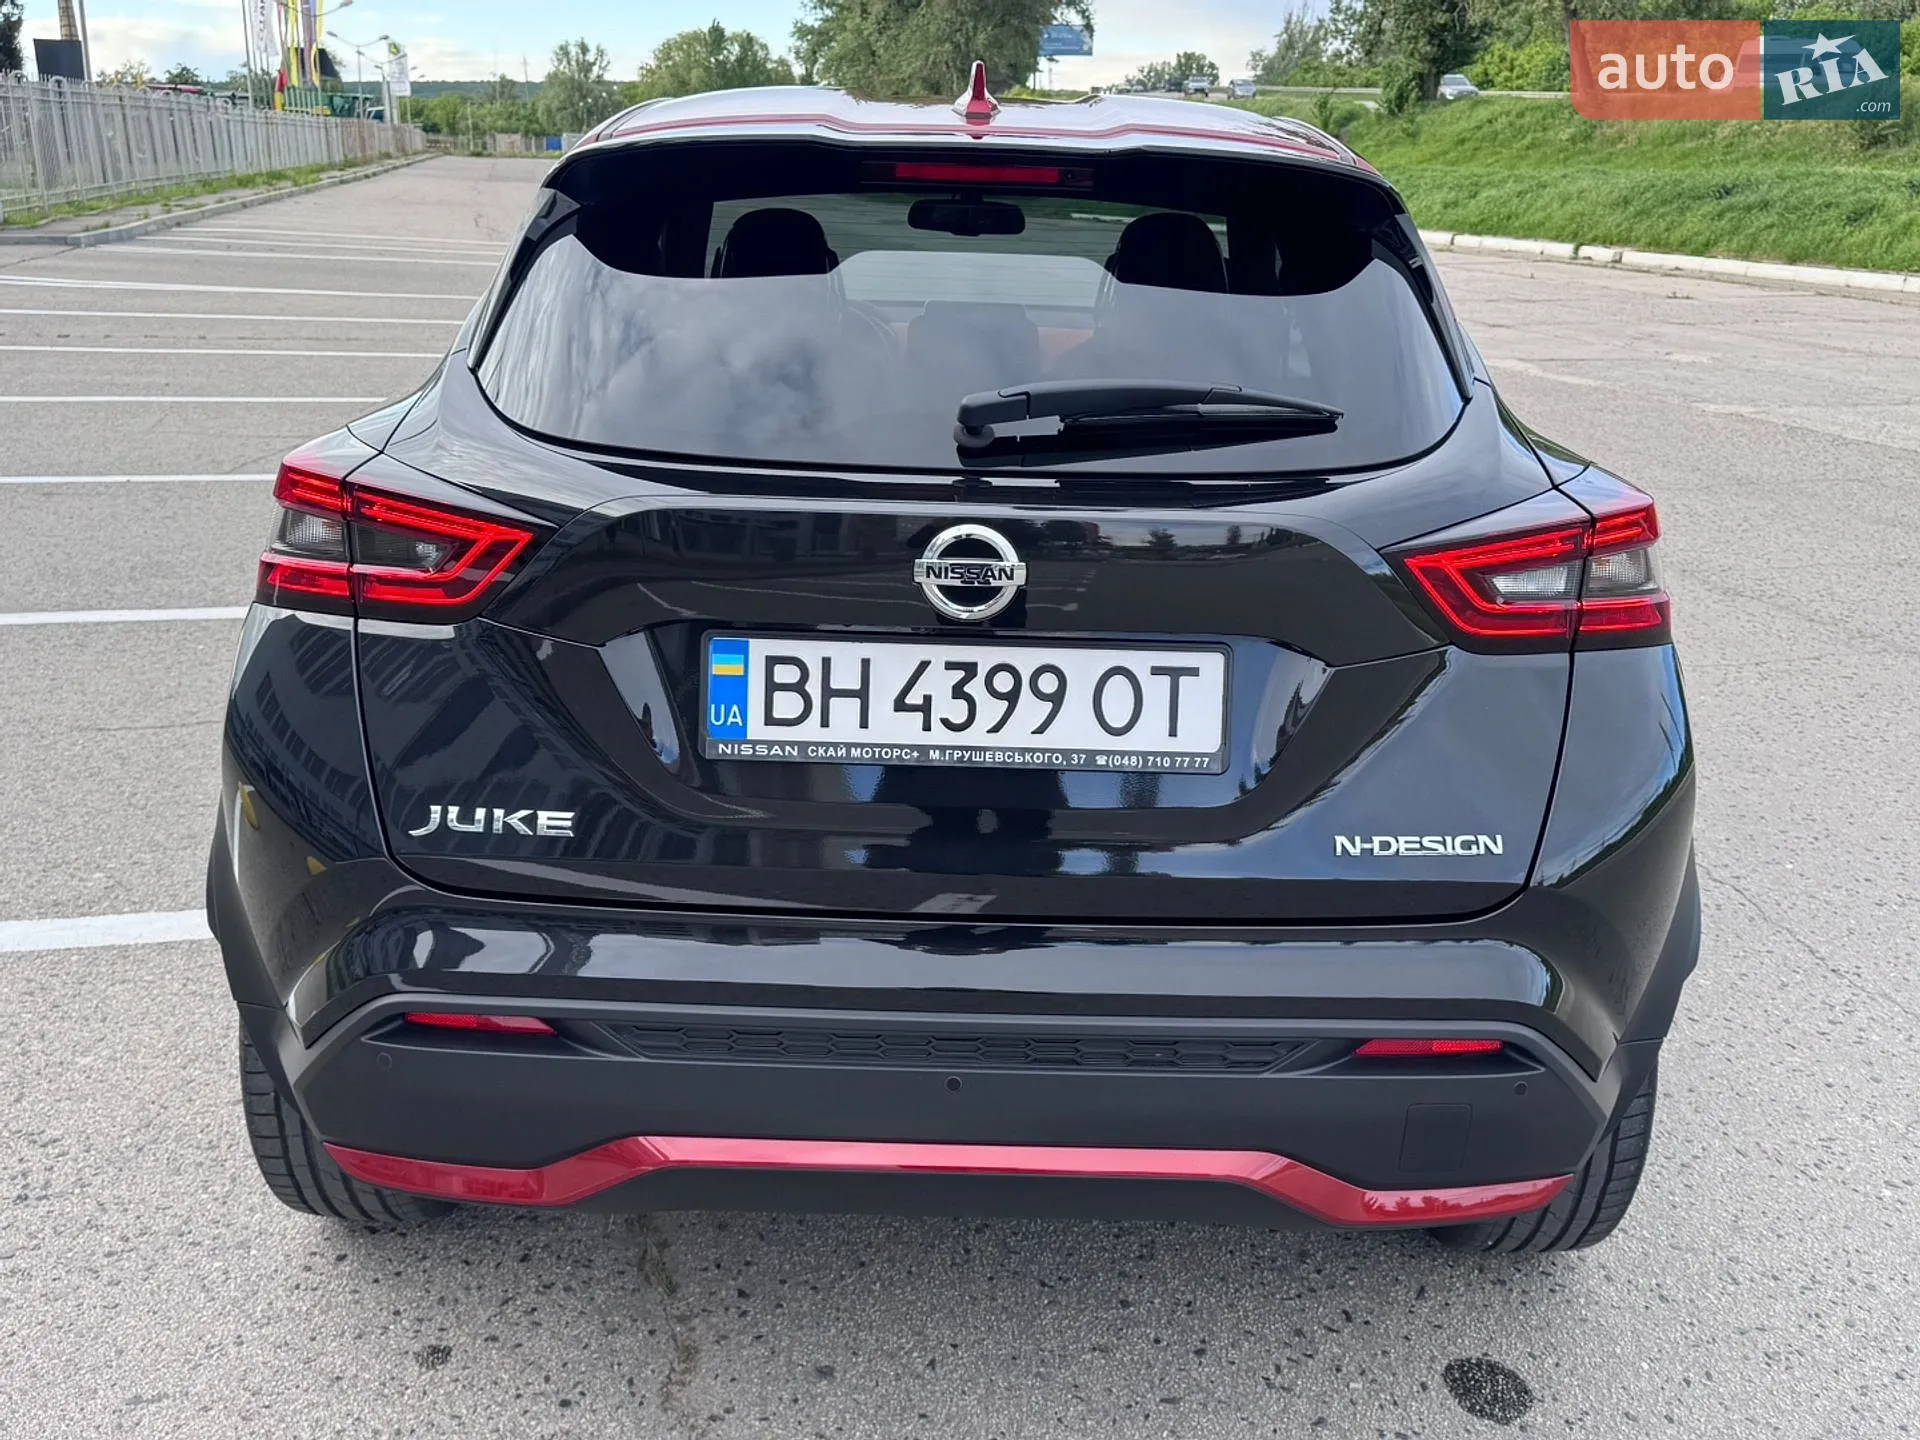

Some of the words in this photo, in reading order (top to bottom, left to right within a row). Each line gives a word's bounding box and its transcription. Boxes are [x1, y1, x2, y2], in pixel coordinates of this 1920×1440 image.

[925, 564, 1015, 581] NISSAN
[763, 654, 871, 729] BH
[893, 659, 1068, 735] 4399
[1092, 665, 1200, 738] OT
[710, 703, 743, 727] UA
[718, 743, 799, 756] NISSAN
[807, 743, 847, 757] СКАЙ
[850, 747, 920, 760] МОТОРС+
[1071, 753, 1087, 765] 37
[1108, 755, 1143, 768] (048)
[1147, 756, 1171, 768] 710
[1174, 757, 1190, 768] 77
[1194, 757, 1210, 769] 77
[407, 805, 576, 837] JUKE
[1334, 834, 1504, 856] N-DESIGN
